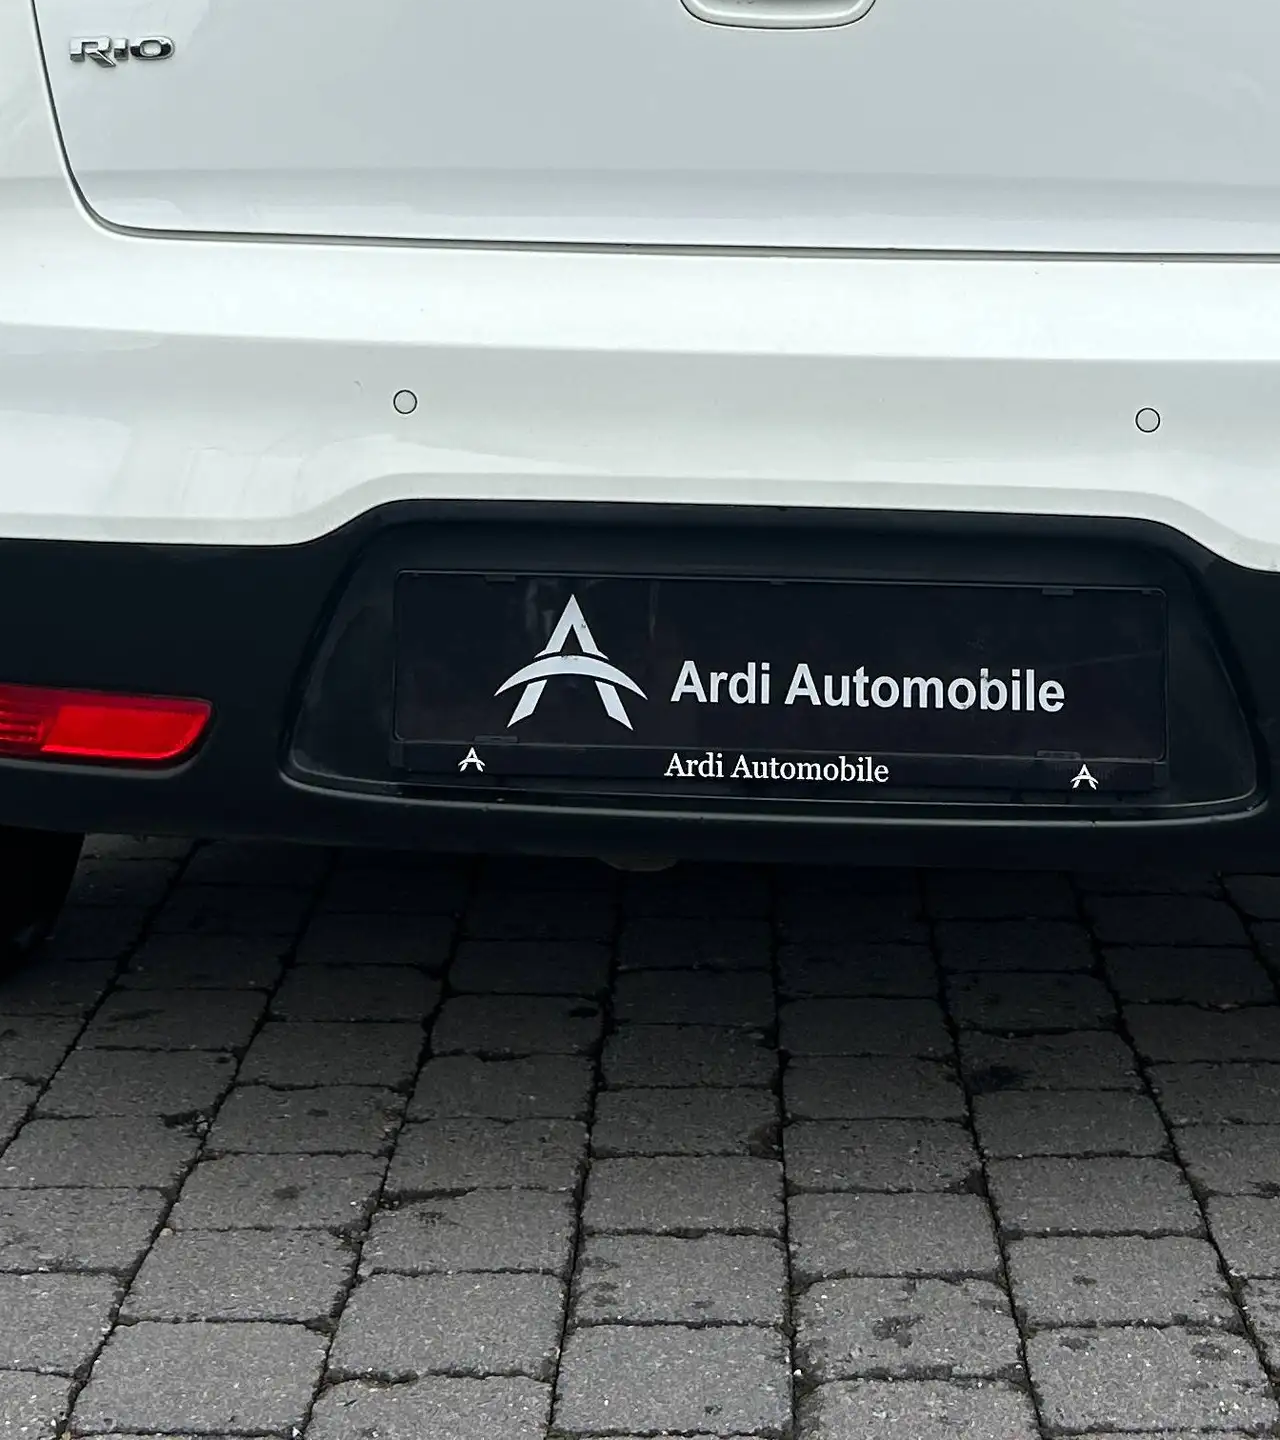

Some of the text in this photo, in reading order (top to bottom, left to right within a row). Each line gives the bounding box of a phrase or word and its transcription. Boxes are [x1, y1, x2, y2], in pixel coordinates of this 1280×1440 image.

[69, 35, 175, 68] RIO
[670, 660, 771, 705] Ardi
[784, 662, 1066, 713] Automobile
[664, 752, 723, 778] Ardi
[729, 756, 890, 783] Automobile
